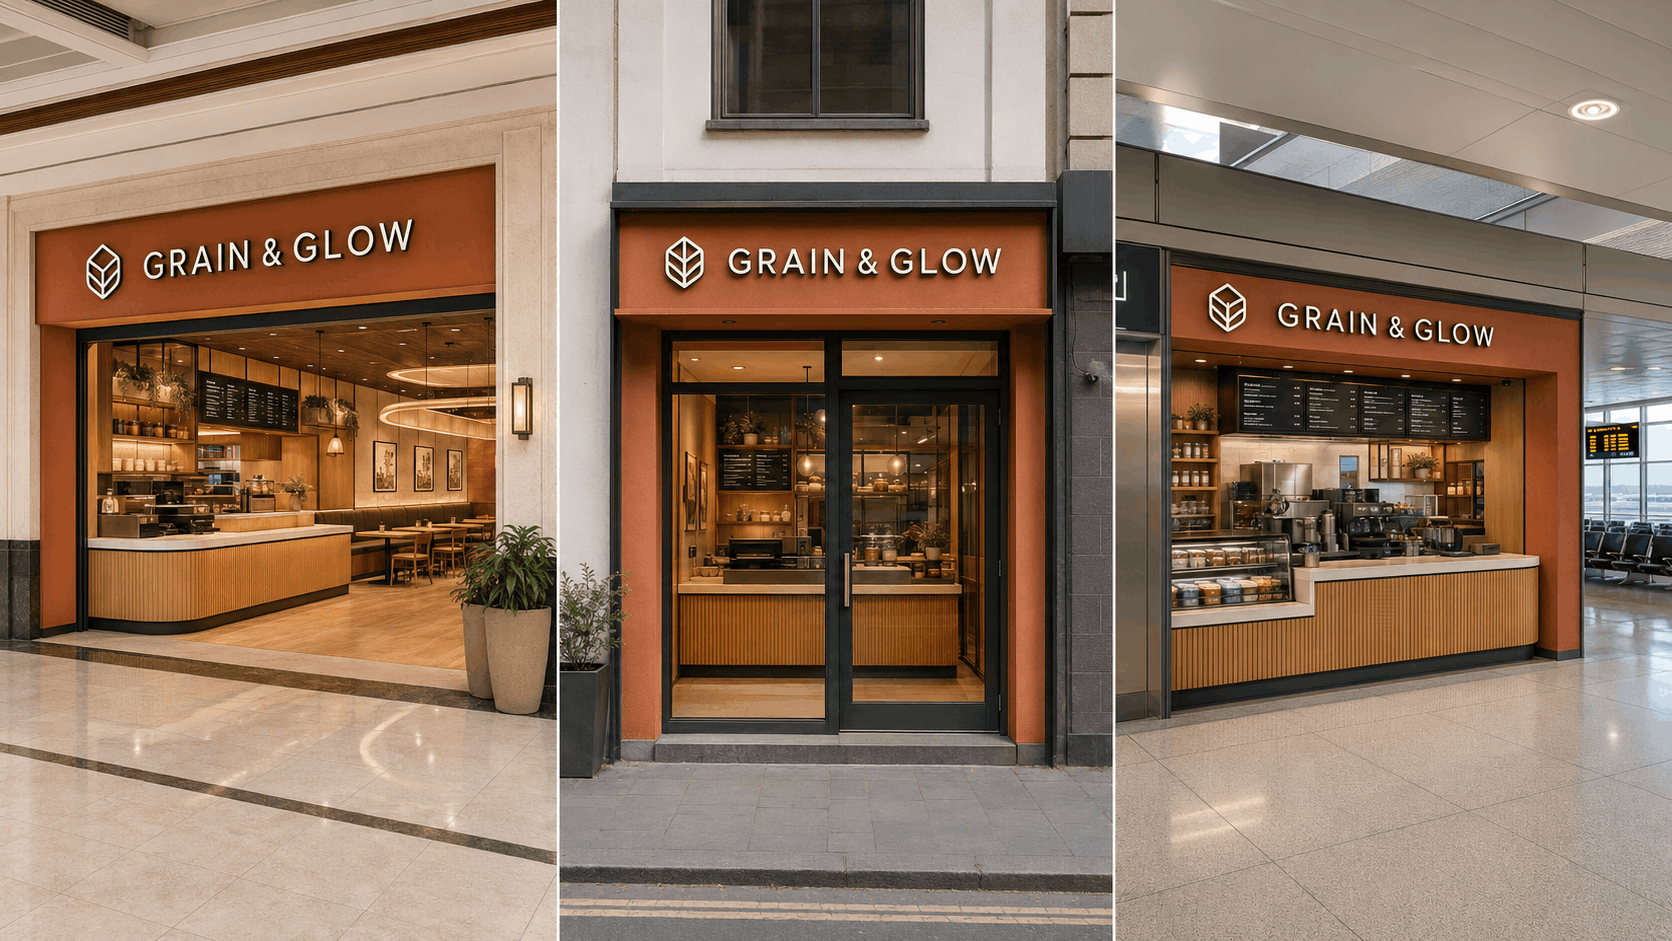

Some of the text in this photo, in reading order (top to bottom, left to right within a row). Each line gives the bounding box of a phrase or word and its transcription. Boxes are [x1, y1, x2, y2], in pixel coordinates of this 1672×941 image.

[143, 218, 414, 280] GRAIN & GLOW
[728, 247, 1003, 275] GRAIN & GLOW
[1278, 302, 1496, 347] GRAIN & GLOW
